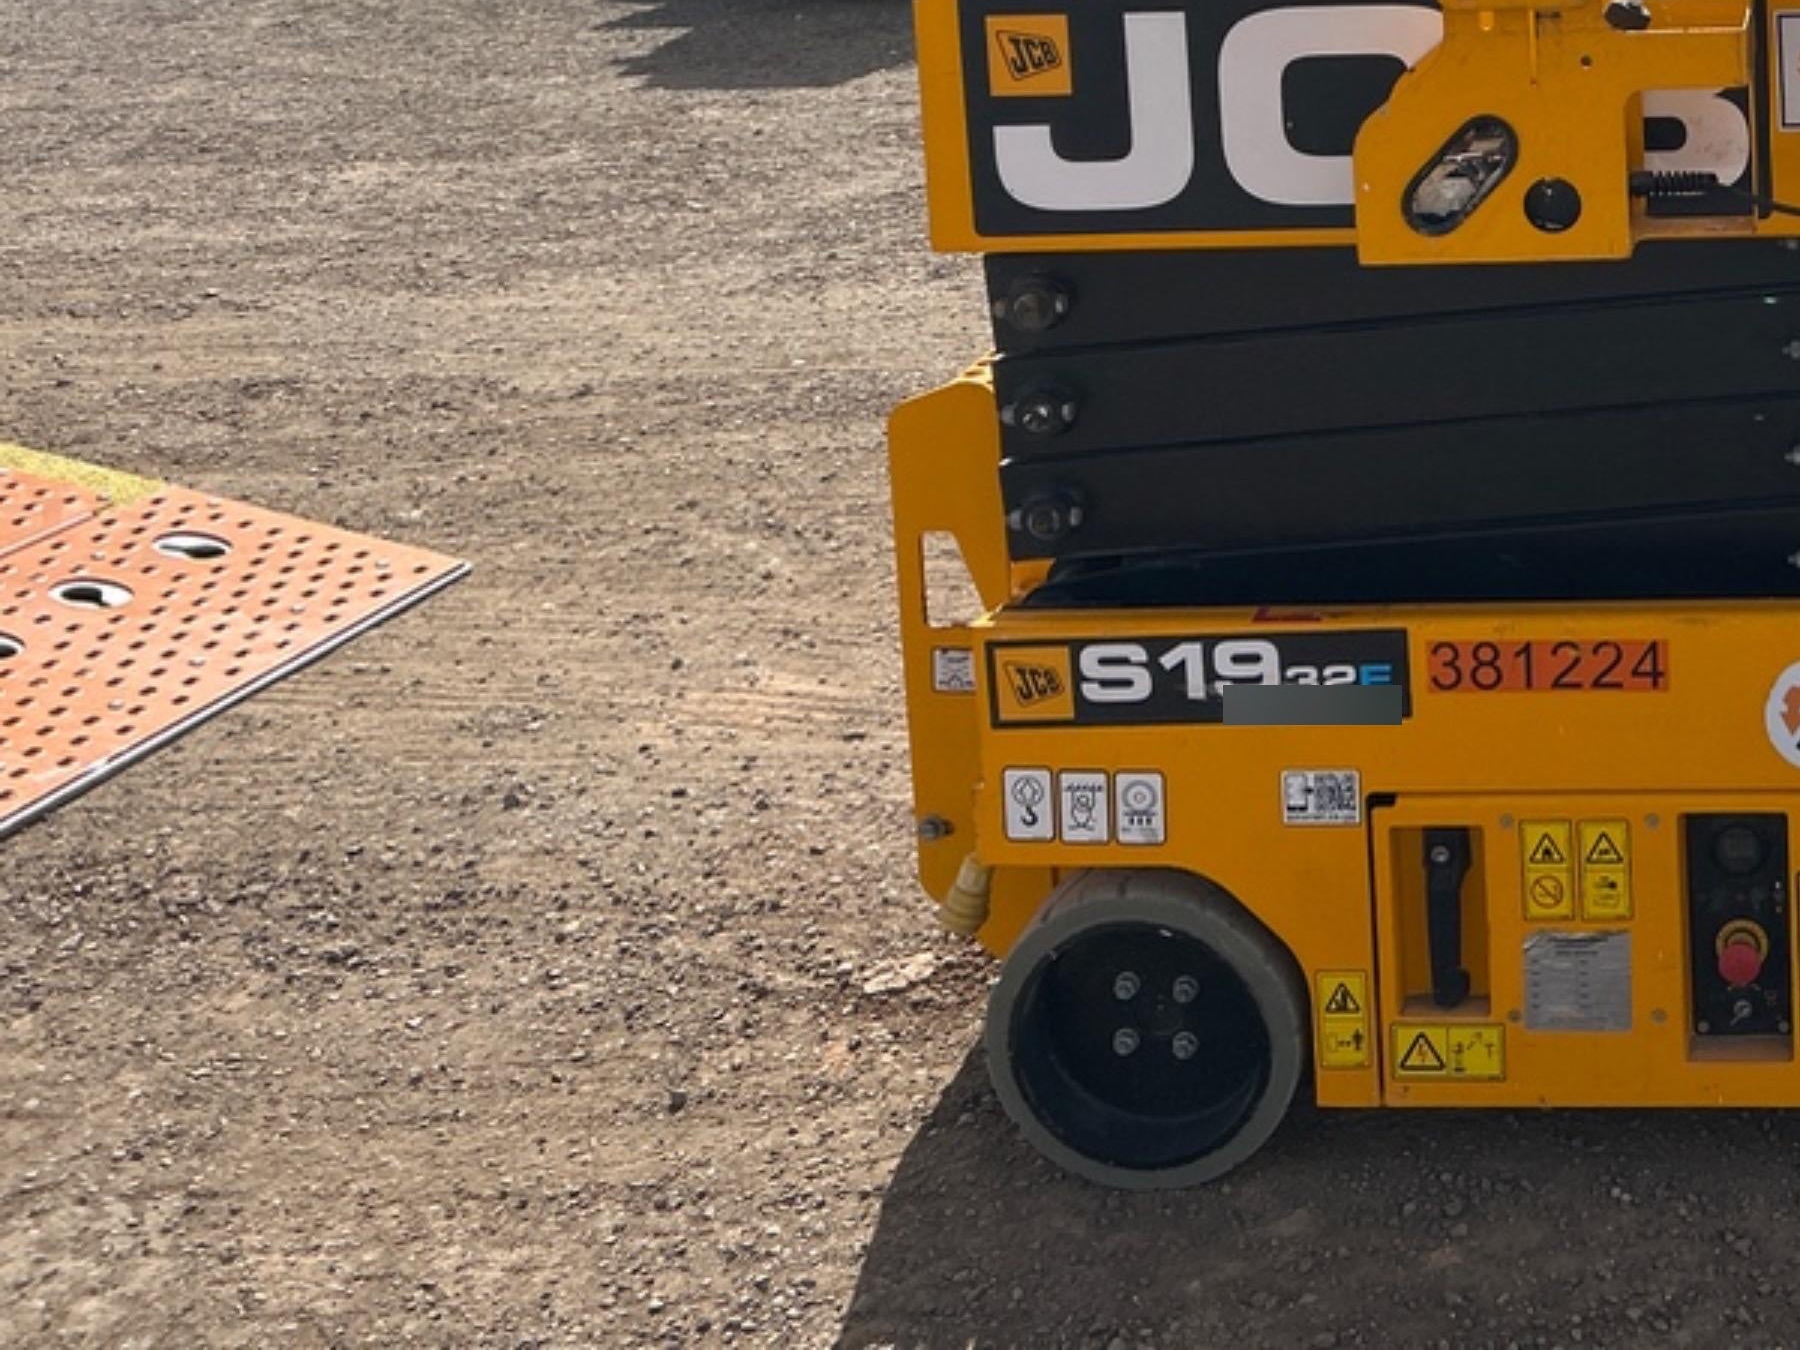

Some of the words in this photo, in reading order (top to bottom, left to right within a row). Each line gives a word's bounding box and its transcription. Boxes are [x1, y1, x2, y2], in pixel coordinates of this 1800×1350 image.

[1005, 33, 1060, 75] JCB
[1013, 664, 1063, 704] JCB
[1430, 640, 1665, 691] 381224
